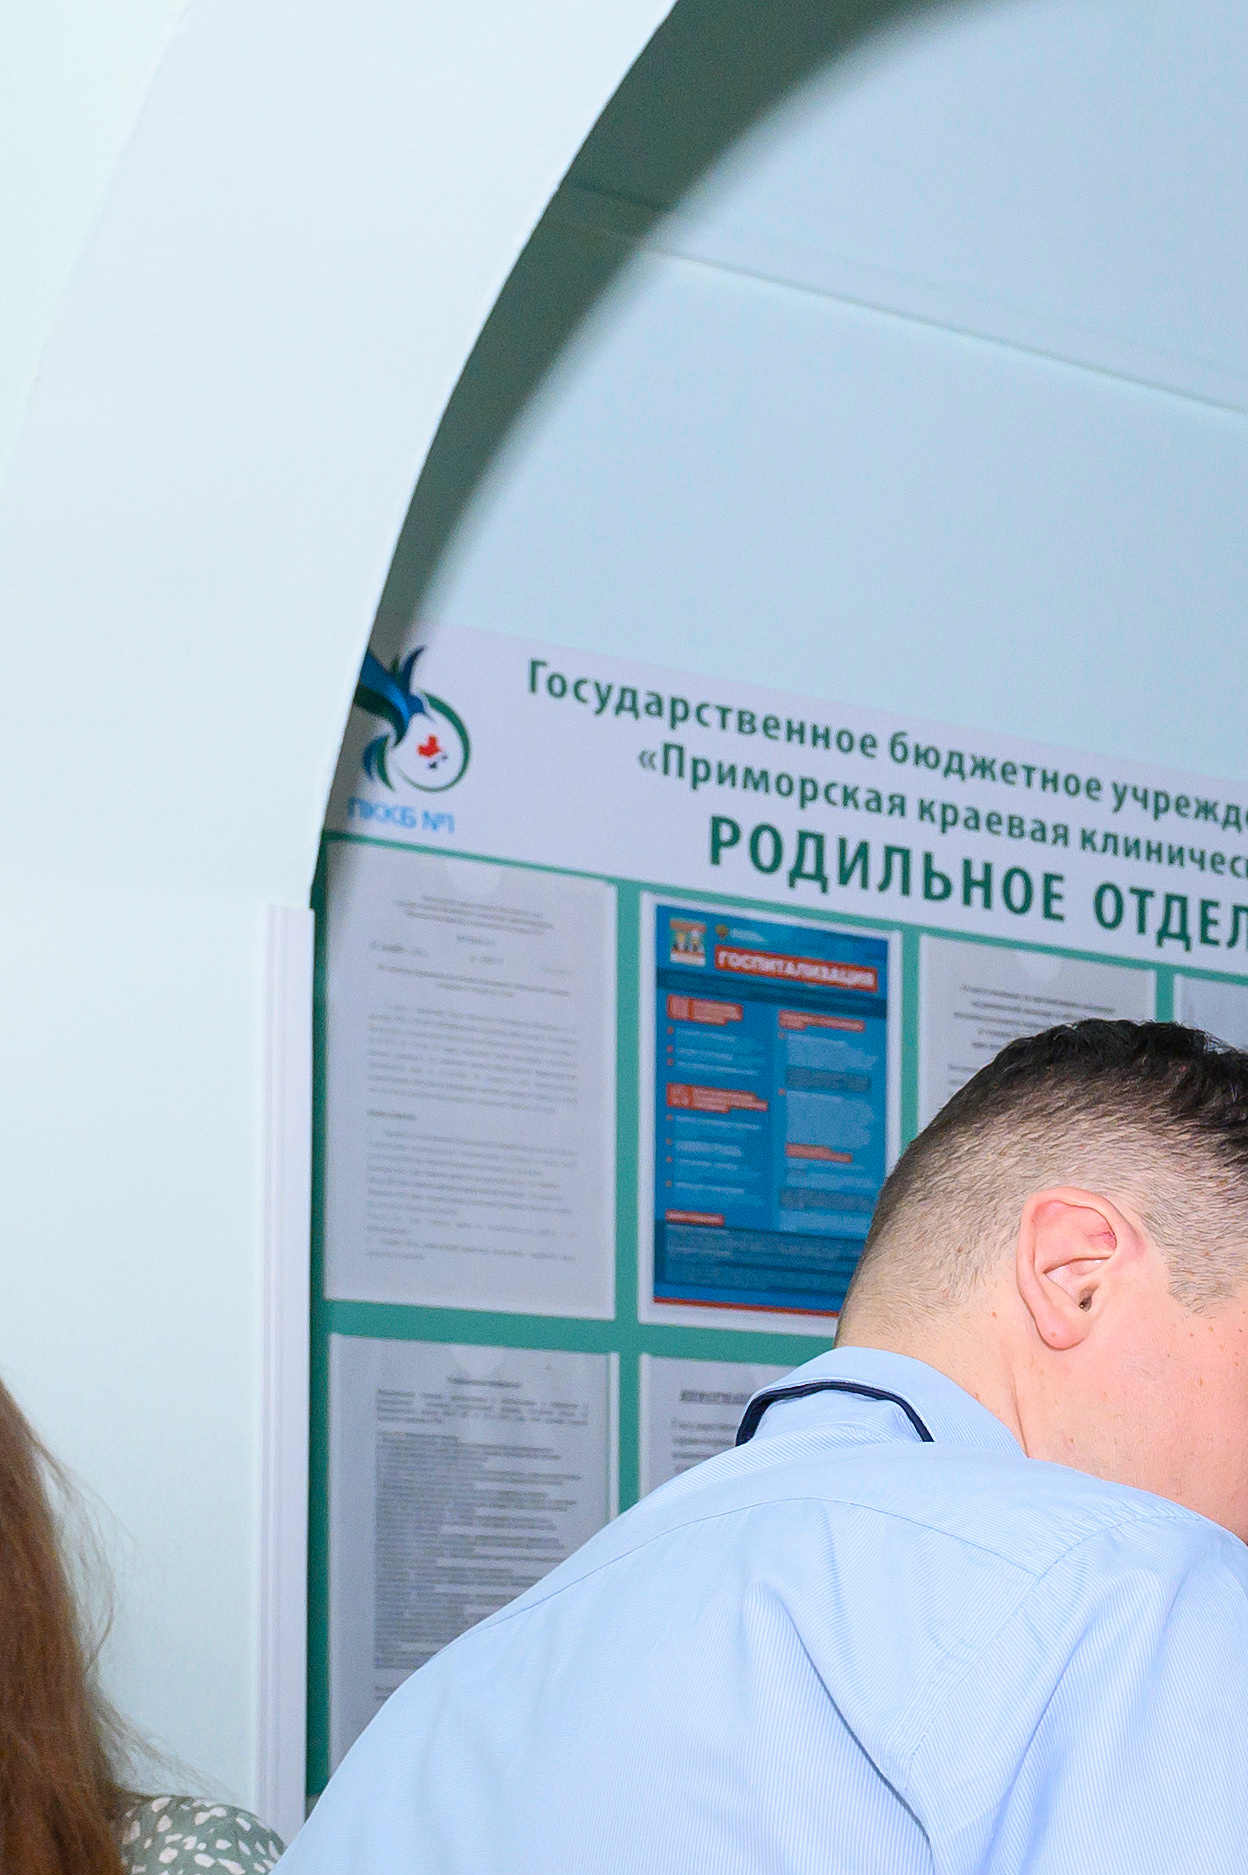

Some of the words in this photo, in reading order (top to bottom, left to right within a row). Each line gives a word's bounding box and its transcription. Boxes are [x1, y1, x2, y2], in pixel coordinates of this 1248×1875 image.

[528, 656, 880, 760] Государственное
[888, 731, 1102, 801] бюджетное
[637, 742, 908, 820] «Приморская
[917, 796, 1070, 849] краевая
[708, 815, 1067, 922] РОДИЛЬНОЕ
